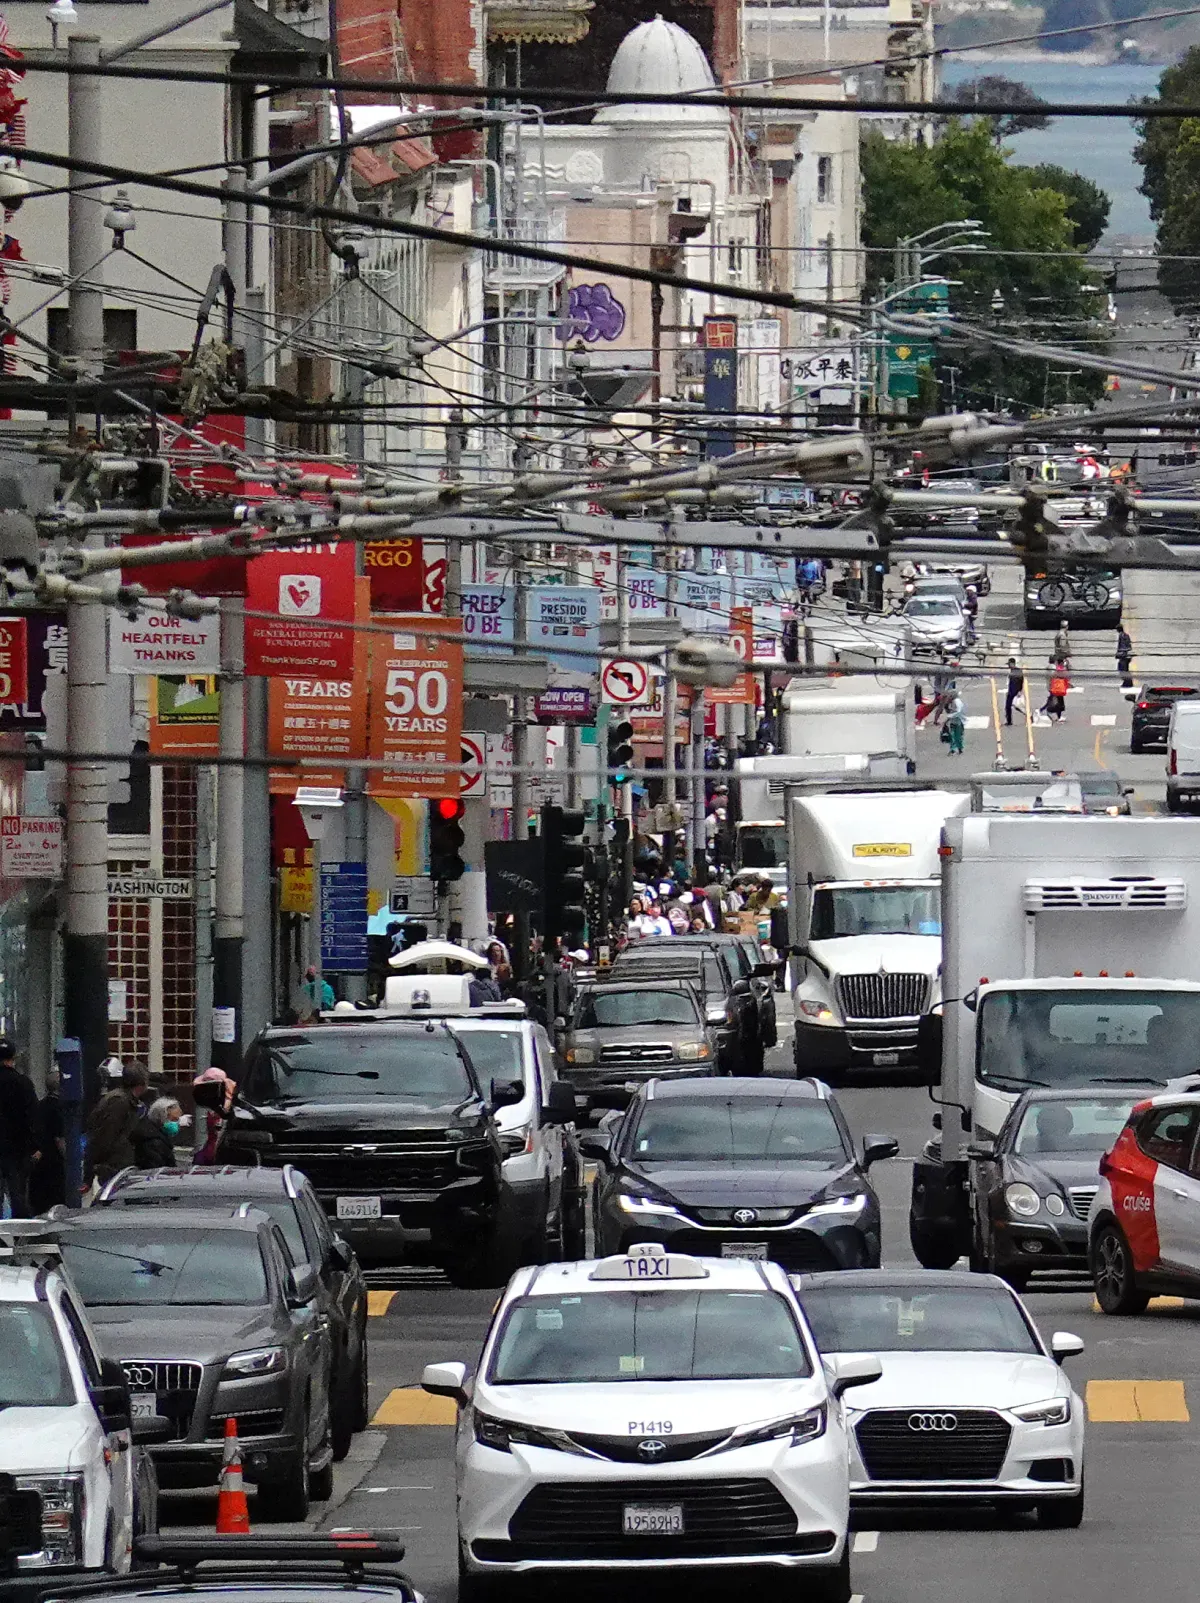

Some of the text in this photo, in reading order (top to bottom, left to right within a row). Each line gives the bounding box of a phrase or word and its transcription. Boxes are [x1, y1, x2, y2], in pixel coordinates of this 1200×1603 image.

[540, 604, 587, 616] PRESIDIO
[148, 616, 181, 627] OUR
[481, 616, 502, 634] BE
[122, 633, 207, 645] HEARTFELT
[254, 629, 344, 639] GENERAL HOSPITAL
[266, 639, 331, 648] FOUNDATION
[134, 650, 196, 661] THANKS
[284, 680, 352, 697] YEARS
[385, 670, 447, 715] 50
[562, 692, 585, 702] OPEN
[384, 717, 447, 732] YEARS
[2, 819, 60, 834] NO PARKING
[1123, 1191, 1151, 1211] cruise
[624, 1258, 670, 1277] TAXI
[628, 1421, 673, 1434] P1419
[626, 1515, 680, 1531] 19589H3
